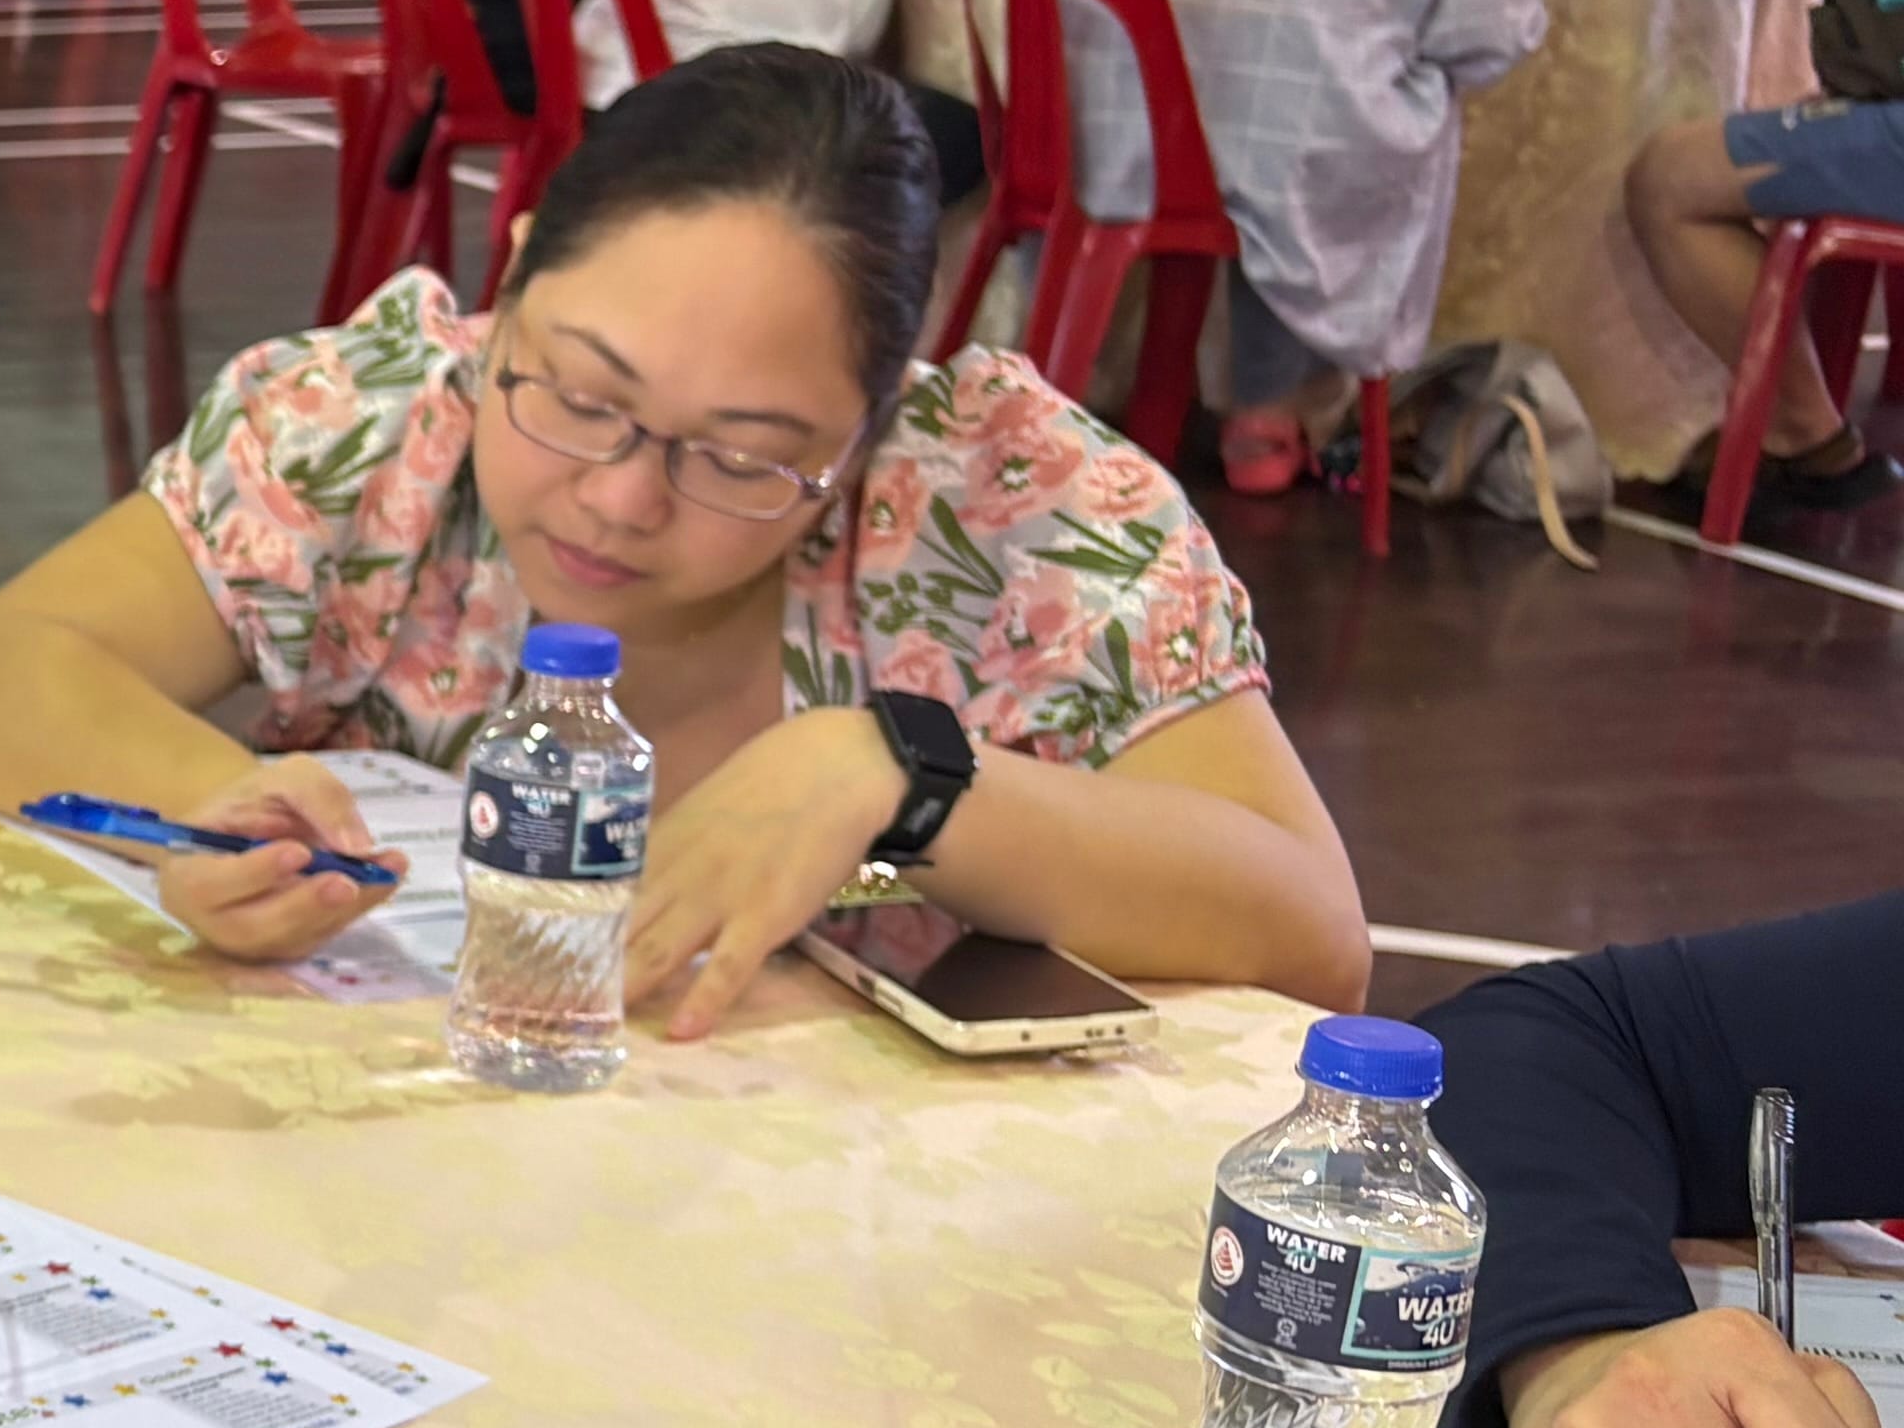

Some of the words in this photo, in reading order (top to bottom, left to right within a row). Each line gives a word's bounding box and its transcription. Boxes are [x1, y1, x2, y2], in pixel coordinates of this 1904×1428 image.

[512, 783, 573, 807] WATER
[1266, 1223, 1347, 1264] WATER
[1284, 1252, 1317, 1275] 4U
[1422, 1318, 1456, 1348] 4U
